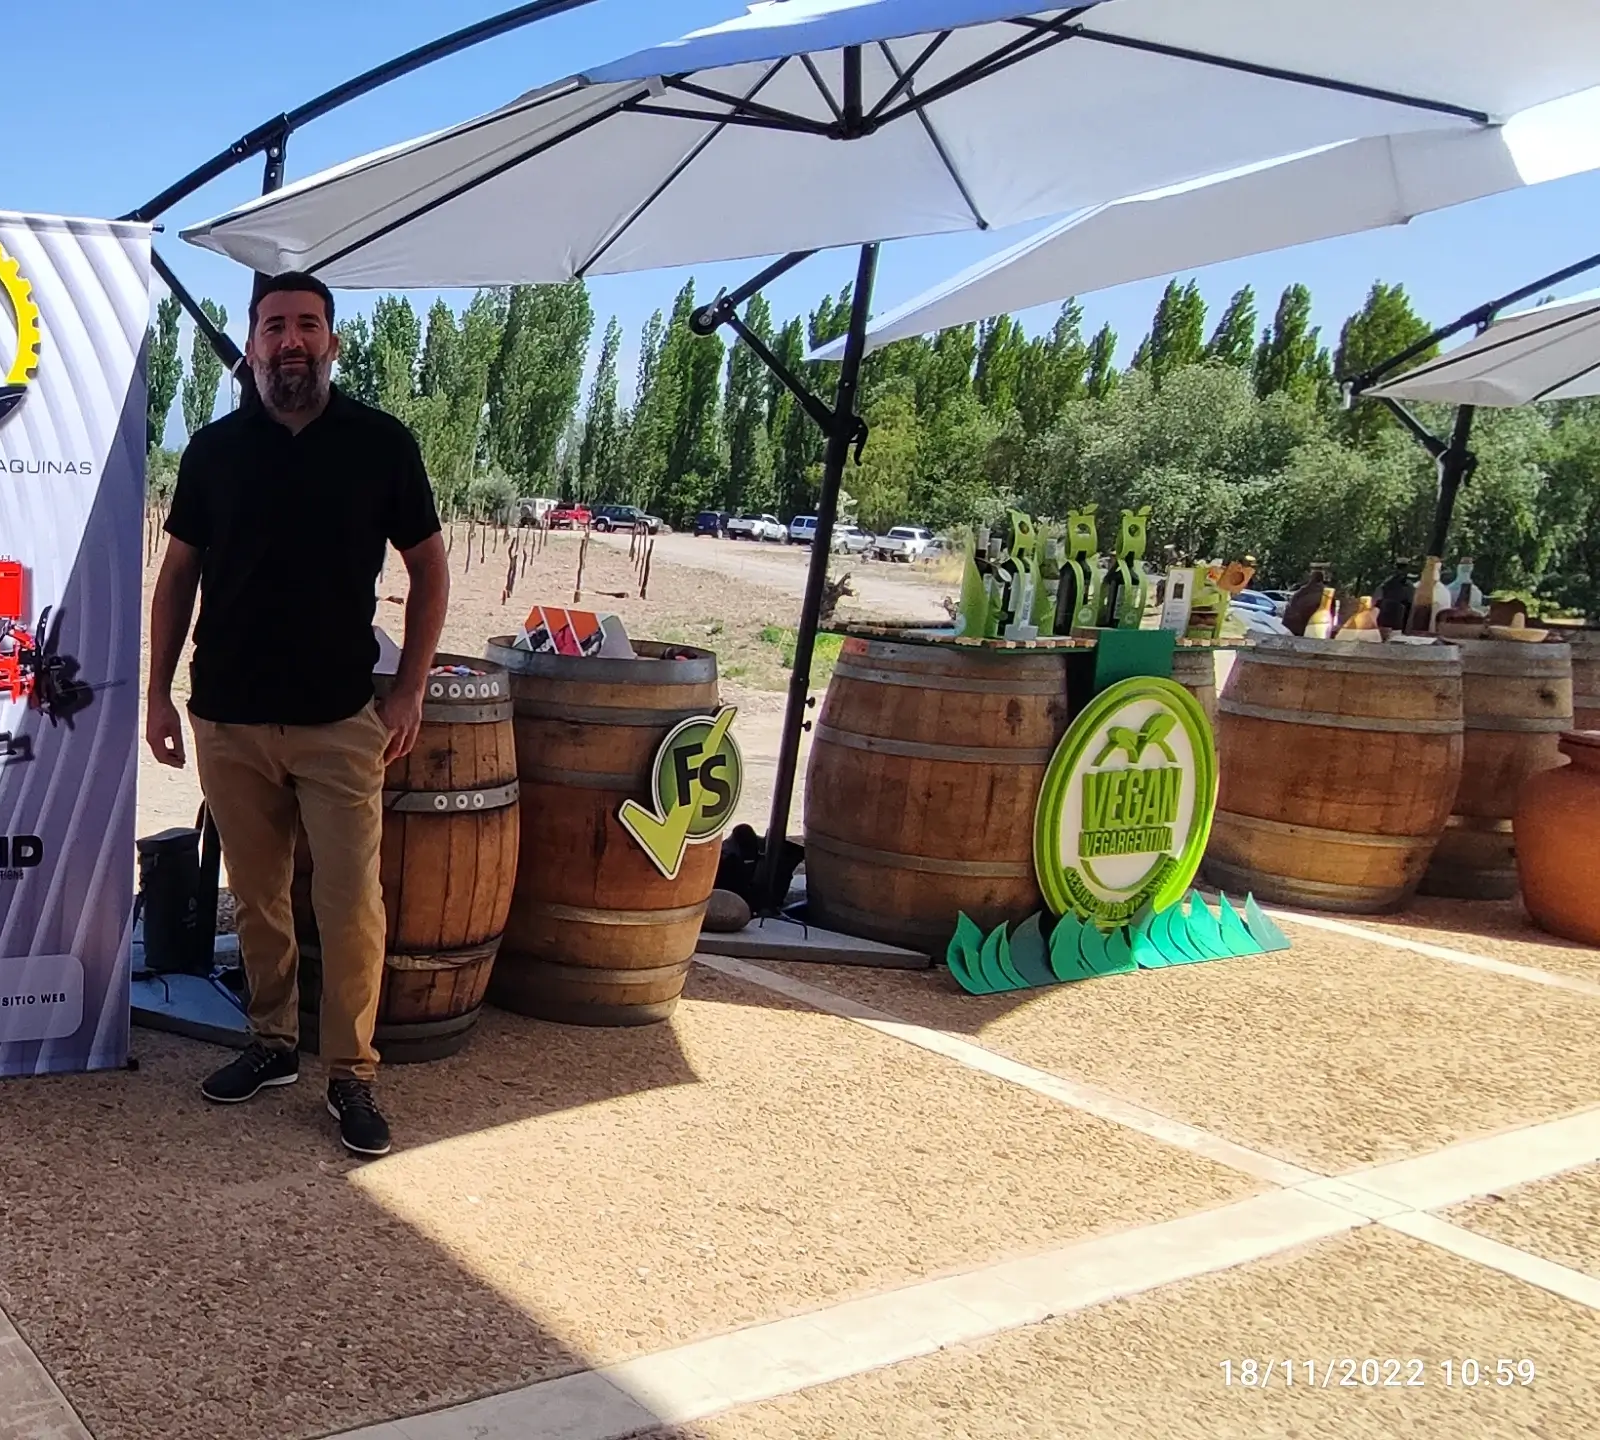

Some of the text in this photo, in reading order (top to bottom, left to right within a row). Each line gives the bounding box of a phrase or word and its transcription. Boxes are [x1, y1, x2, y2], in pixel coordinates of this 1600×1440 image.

[673, 742, 731, 818] FS
[1082, 766, 1182, 831] VEGAN
[1079, 826, 1172, 857] VEGARGENTINA
[1, 995, 36, 1007] SITIO
[40, 992, 67, 1004] WEB
